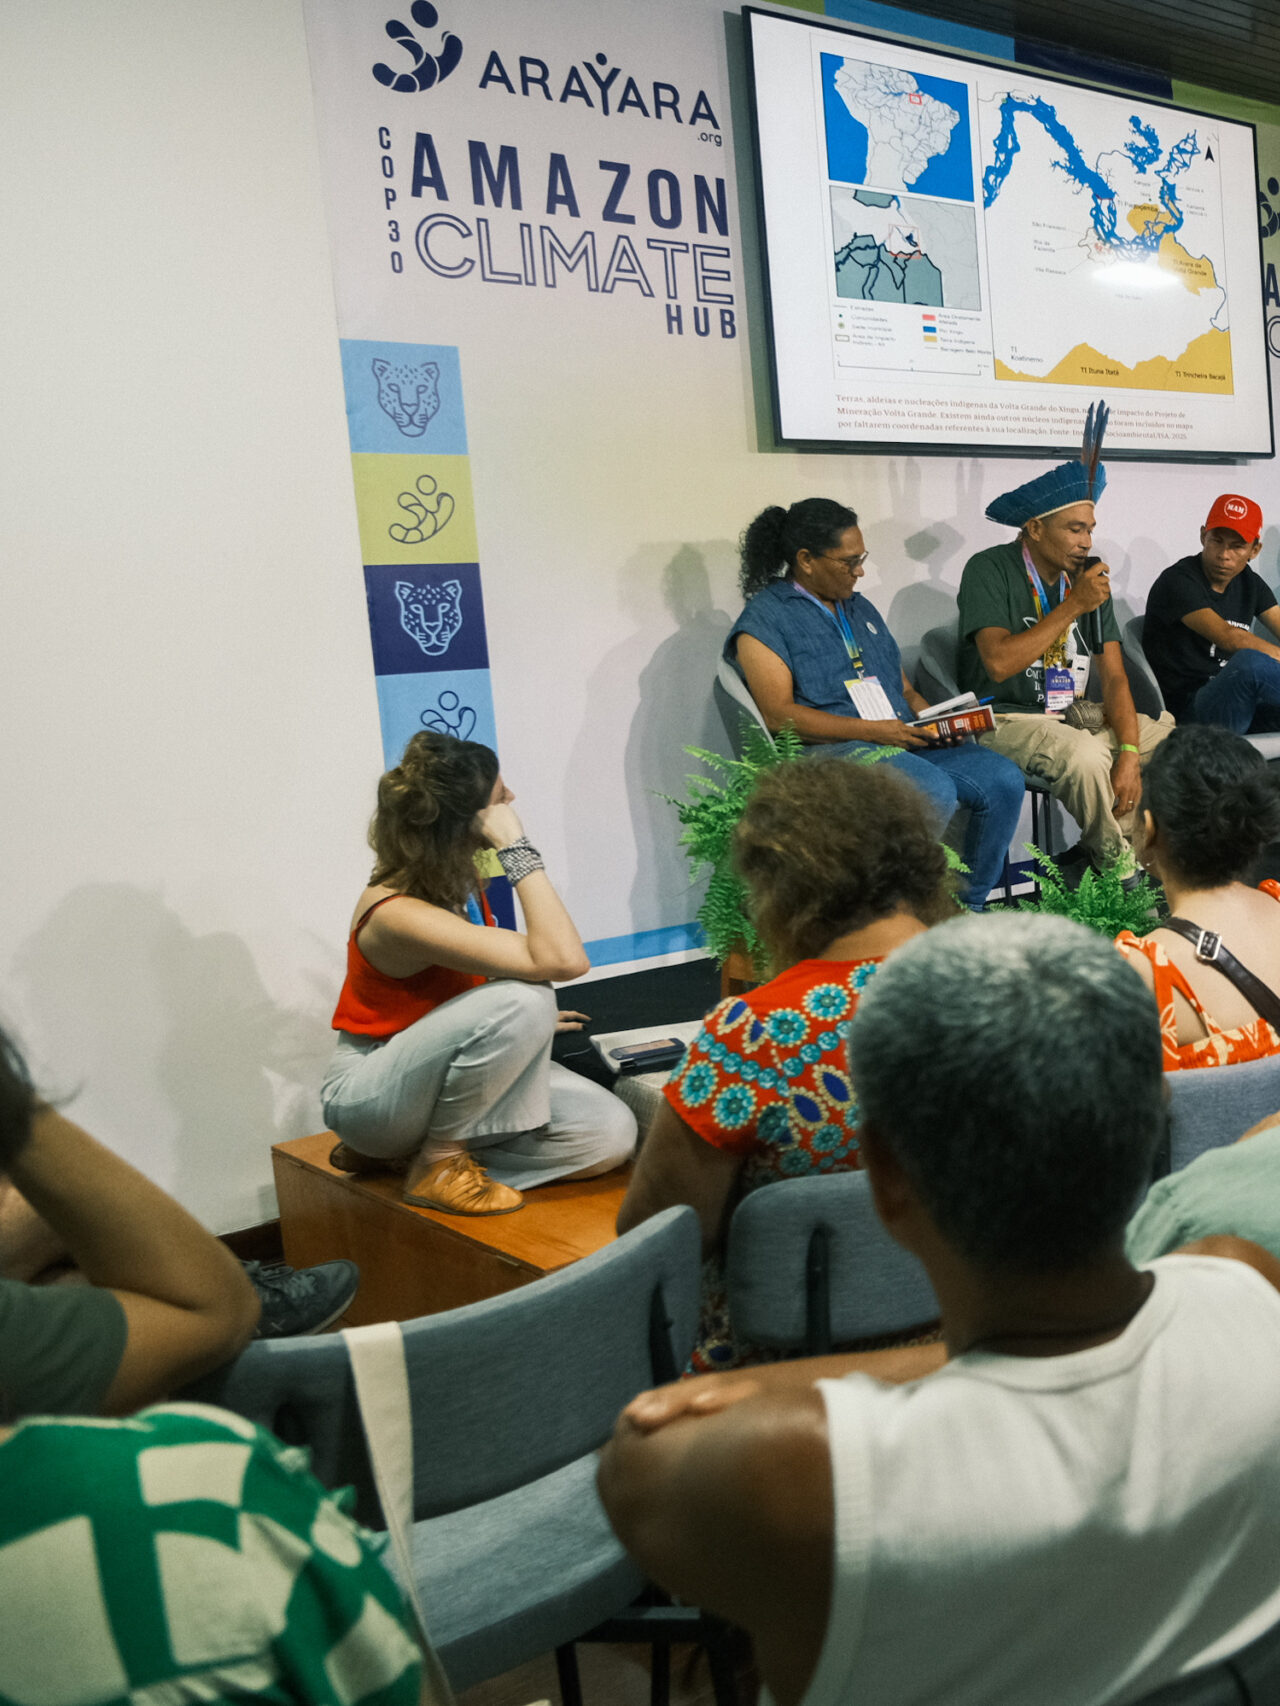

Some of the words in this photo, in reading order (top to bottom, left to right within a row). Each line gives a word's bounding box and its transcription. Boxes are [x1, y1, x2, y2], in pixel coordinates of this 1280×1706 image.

[479, 51, 721, 130] ARAYARA
[696, 132, 722, 147] .org
[410, 132, 730, 237] AMAZON
[415, 213, 734, 305] CLIMATE
[666, 303, 737, 339] HUB
